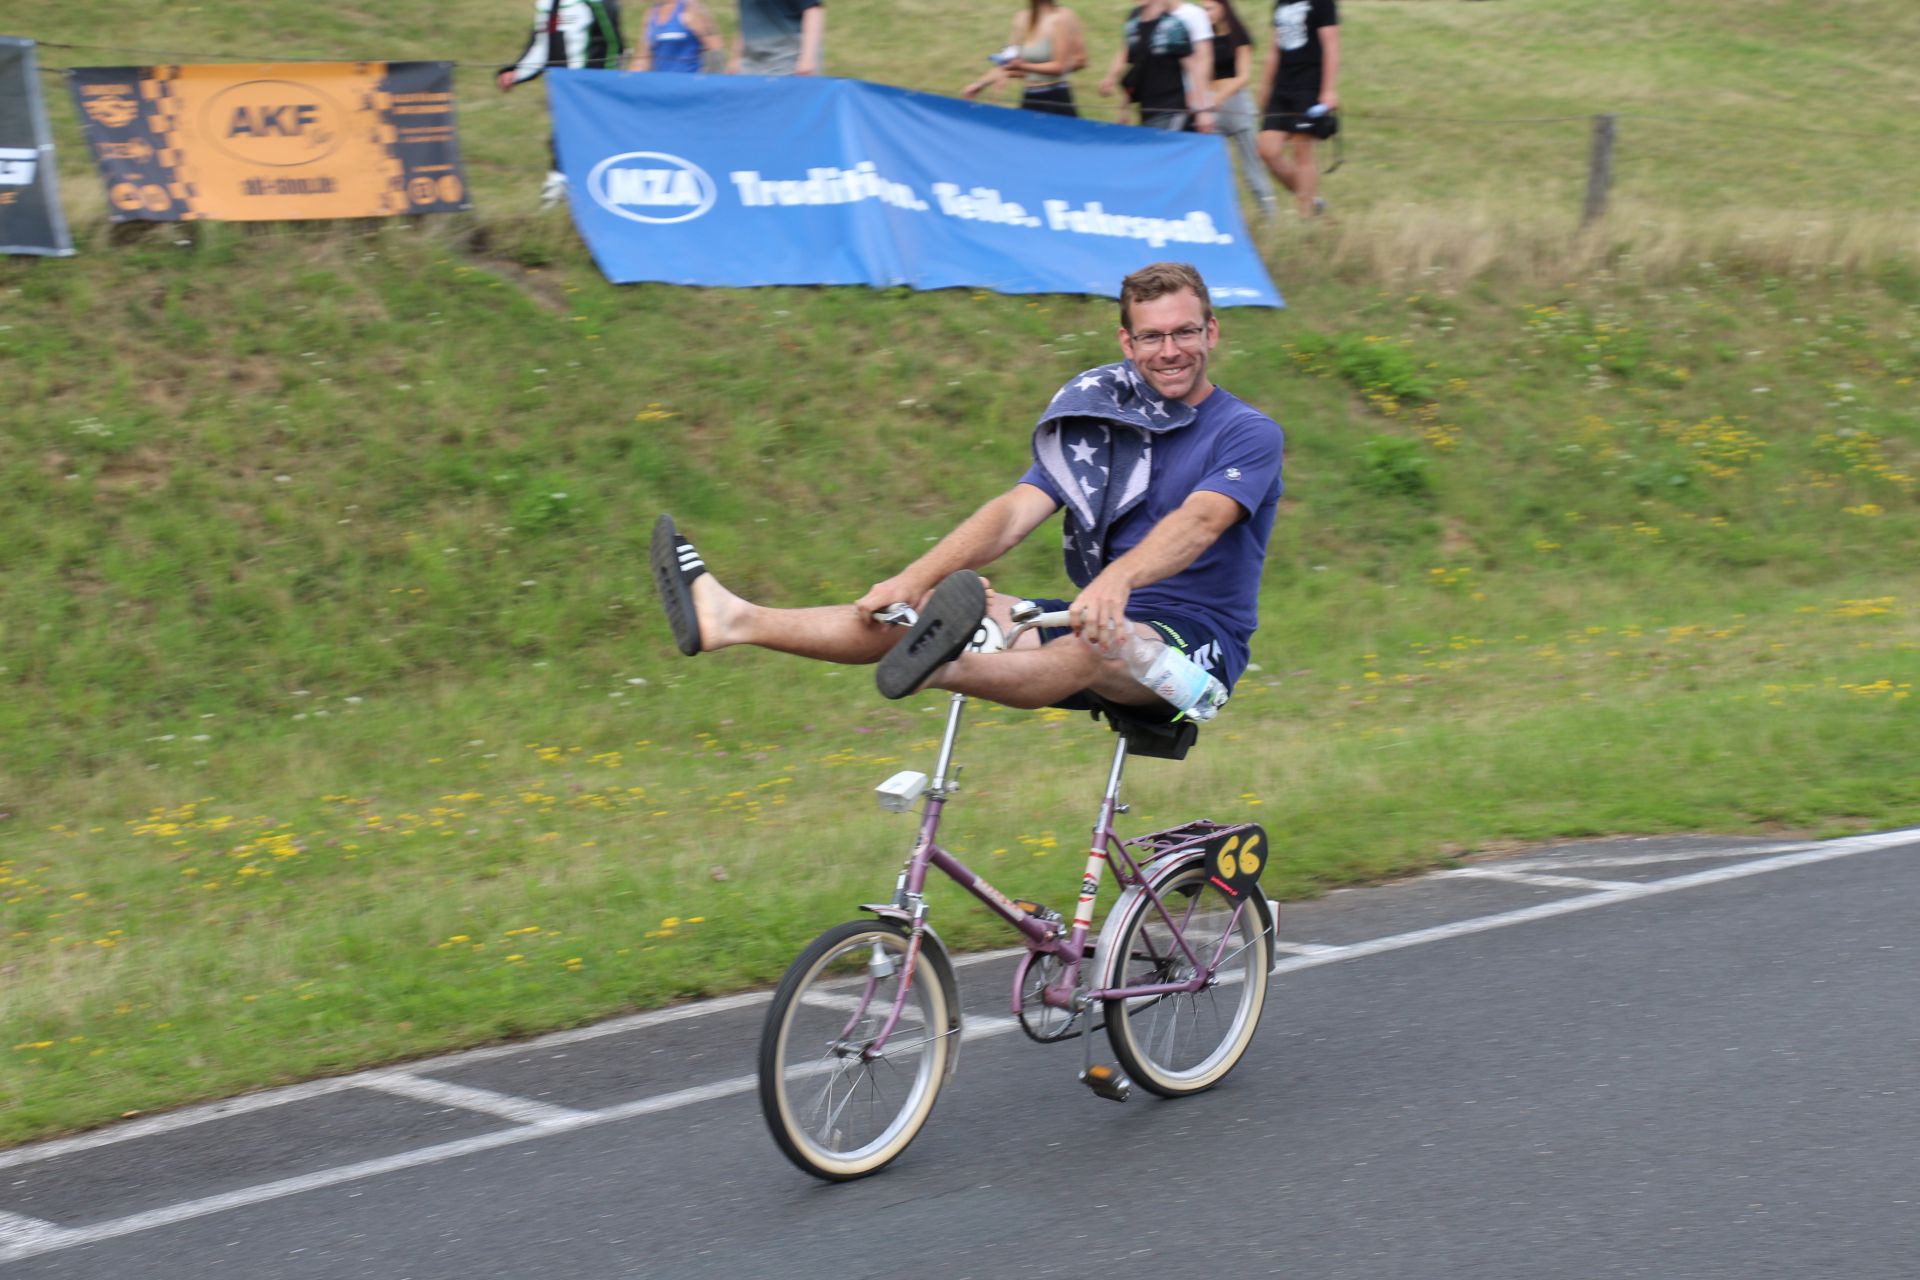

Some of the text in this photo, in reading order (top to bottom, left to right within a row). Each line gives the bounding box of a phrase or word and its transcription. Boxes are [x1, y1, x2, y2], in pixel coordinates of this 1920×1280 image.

[226, 104, 320, 138] AKF
[607, 168, 702, 206] MZA
[1217, 834, 1260, 879] 66
